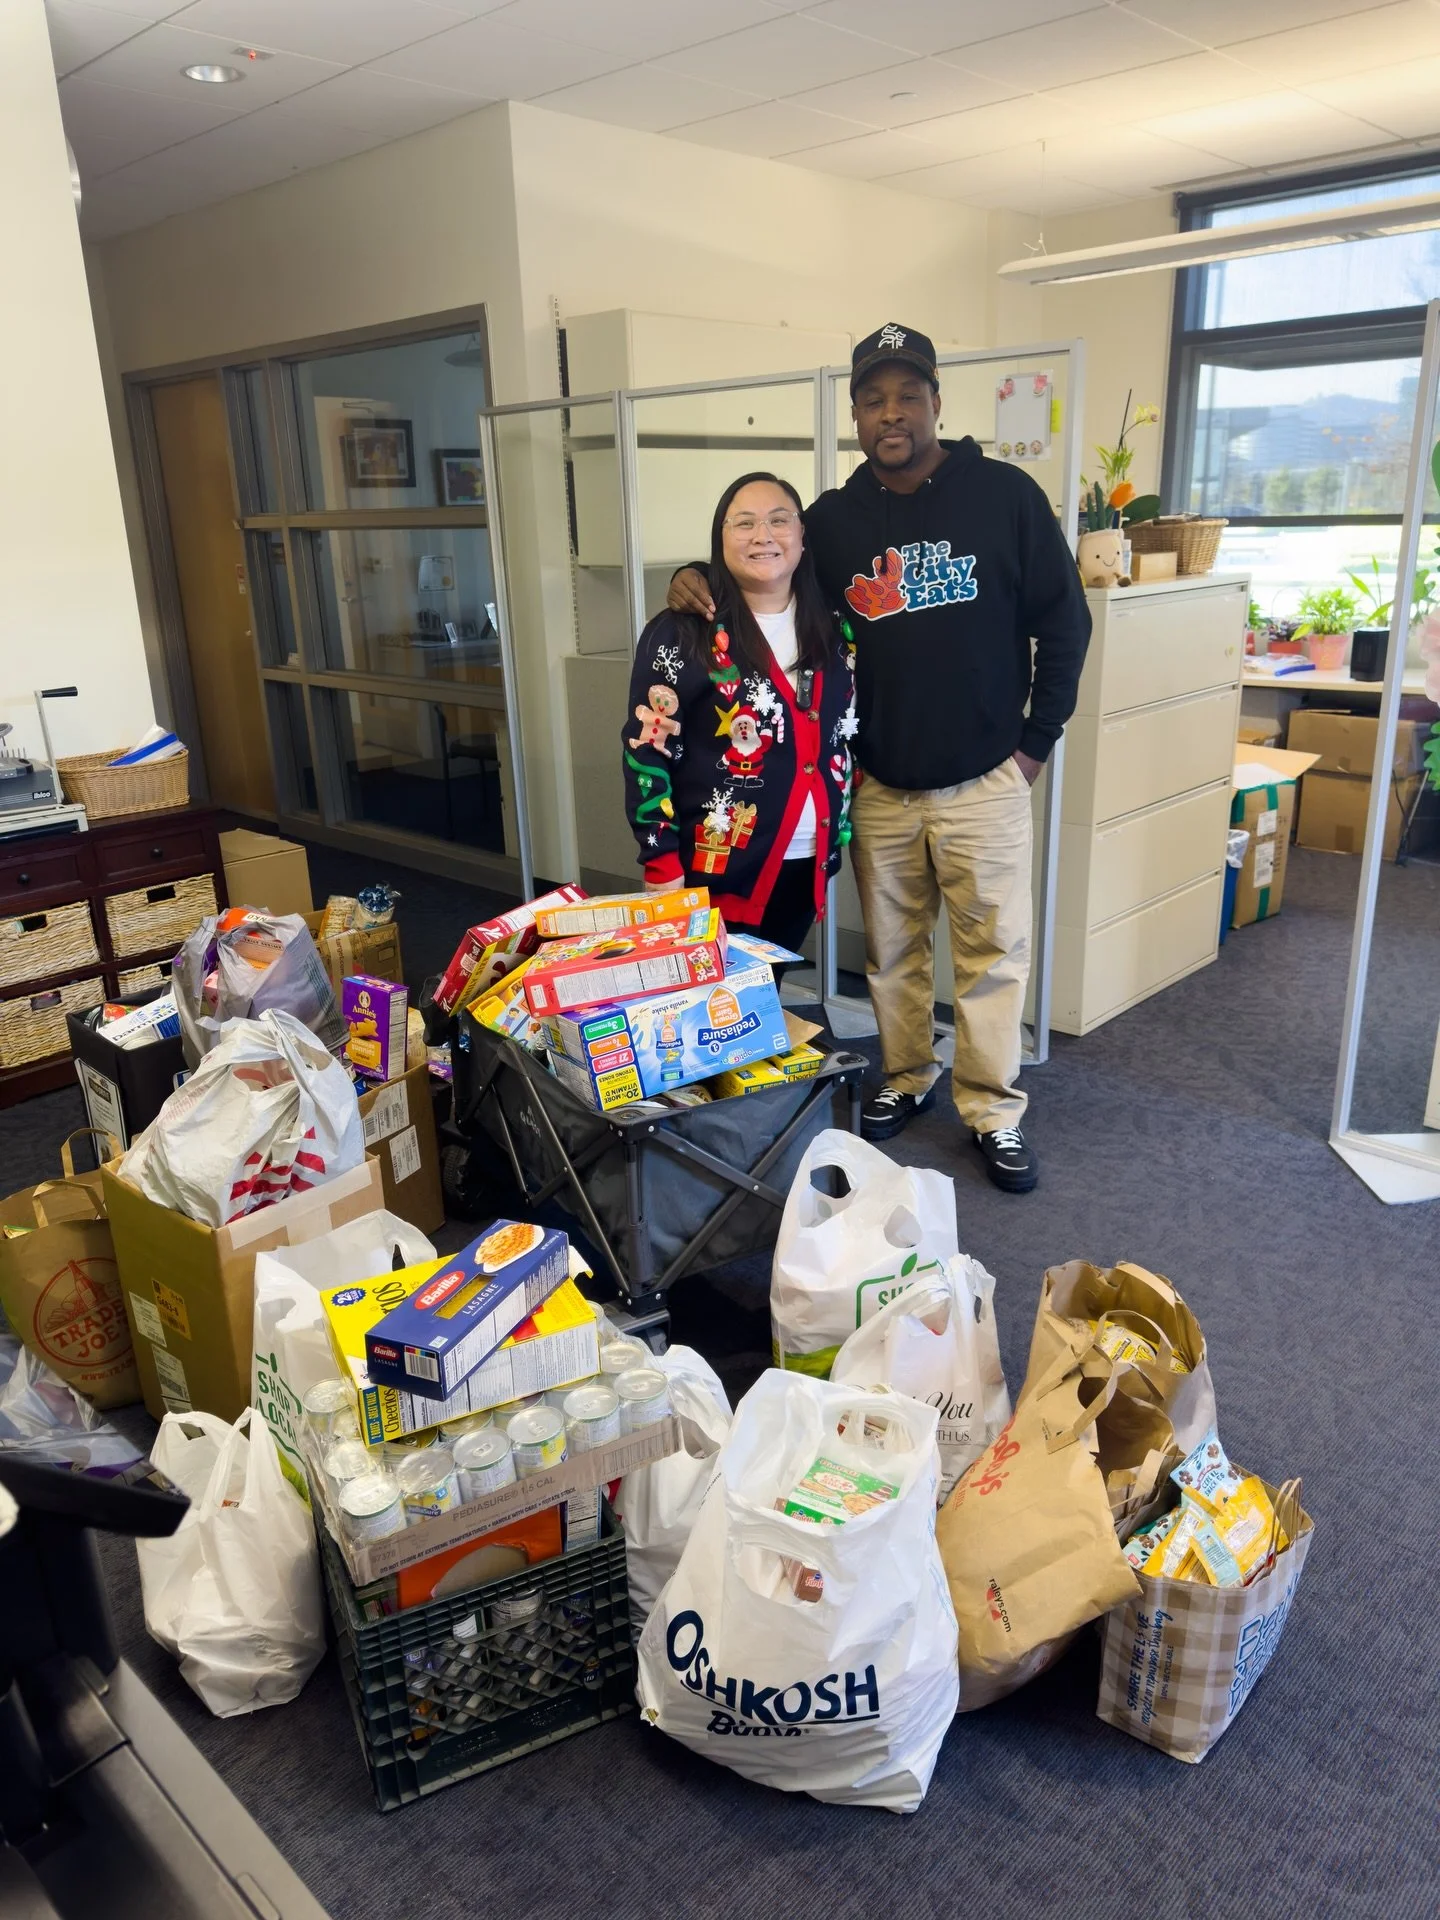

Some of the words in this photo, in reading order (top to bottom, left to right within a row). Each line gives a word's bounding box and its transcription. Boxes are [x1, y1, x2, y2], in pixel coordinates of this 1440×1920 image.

[901, 540, 952, 563] The
[902, 555, 977, 587] City
[905, 576, 978, 612] Eats
[112, 1007, 177, 1042] parmalat
[352, 1005, 377, 1019] Annie's
[652, 1004, 669, 1015] shake
[702, 1017, 757, 1041] PediaSure
[421, 1273, 460, 1305] Barilla
[462, 1283, 499, 1315] LASAGNE
[373, 1346, 398, 1359] Barilla
[257, 1370, 291, 1415] SHOP
[926, 1391, 976, 1420] You
[258, 1396, 298, 1449] LOCA
[384, 1388, 400, 1434] Cheerios
[936, 1429, 952, 1441] TH
[954, 1430, 972, 1442] US.
[536, 1476, 556, 1489] CAL
[424, 1541, 449, 1556] EXTREME
[491, 1514, 512, 1528] HANDLE
[511, 1508, 525, 1519] WITH
[988, 1578, 1012, 1633] raleys.com
[1144, 1628, 1162, 1649] this
[1131, 1645, 1146, 1671] THE
[1162, 1645, 1175, 1684] RECYCLABLE
[1127, 1670, 1142, 1711] SHARE
